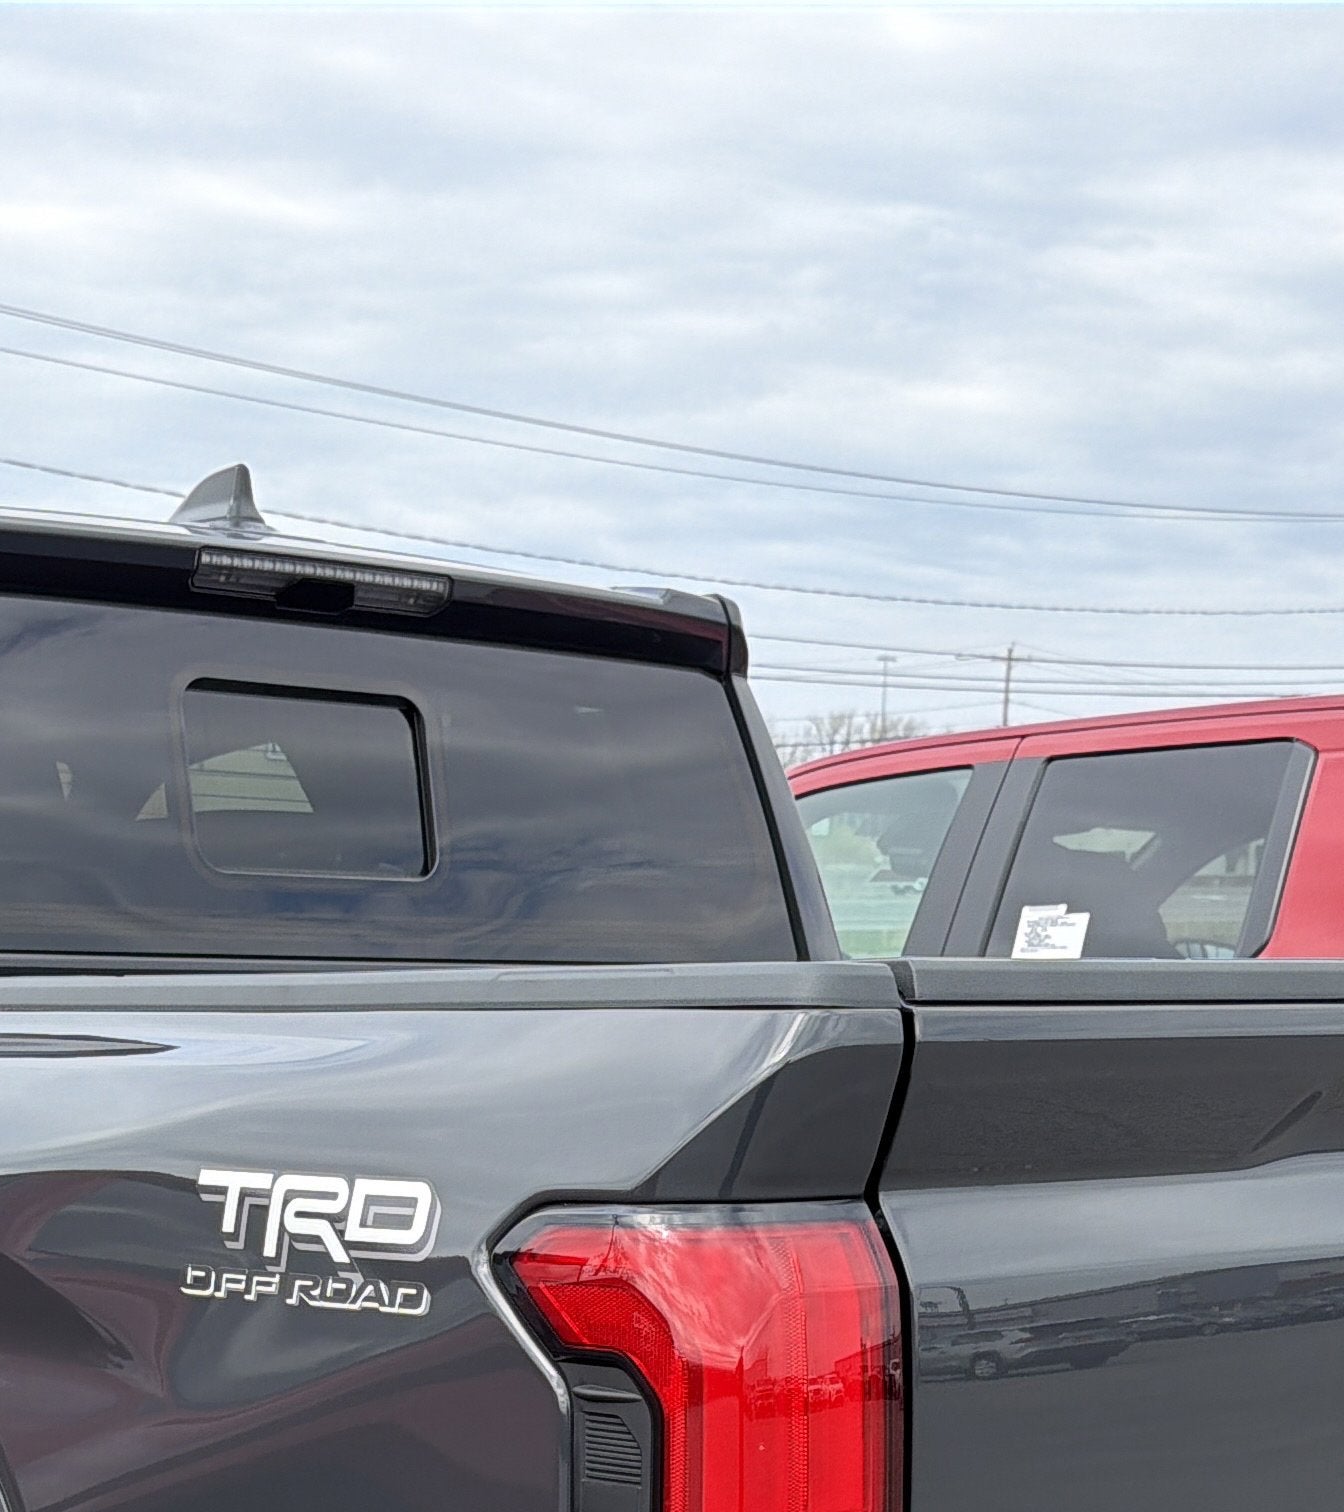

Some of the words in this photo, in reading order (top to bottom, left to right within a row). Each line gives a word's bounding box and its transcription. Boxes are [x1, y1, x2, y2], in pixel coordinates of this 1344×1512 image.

[196, 1168, 442, 1272] TRD
[179, 1264, 280, 1301] OFF
[285, 1271, 432, 1317] ROAD
